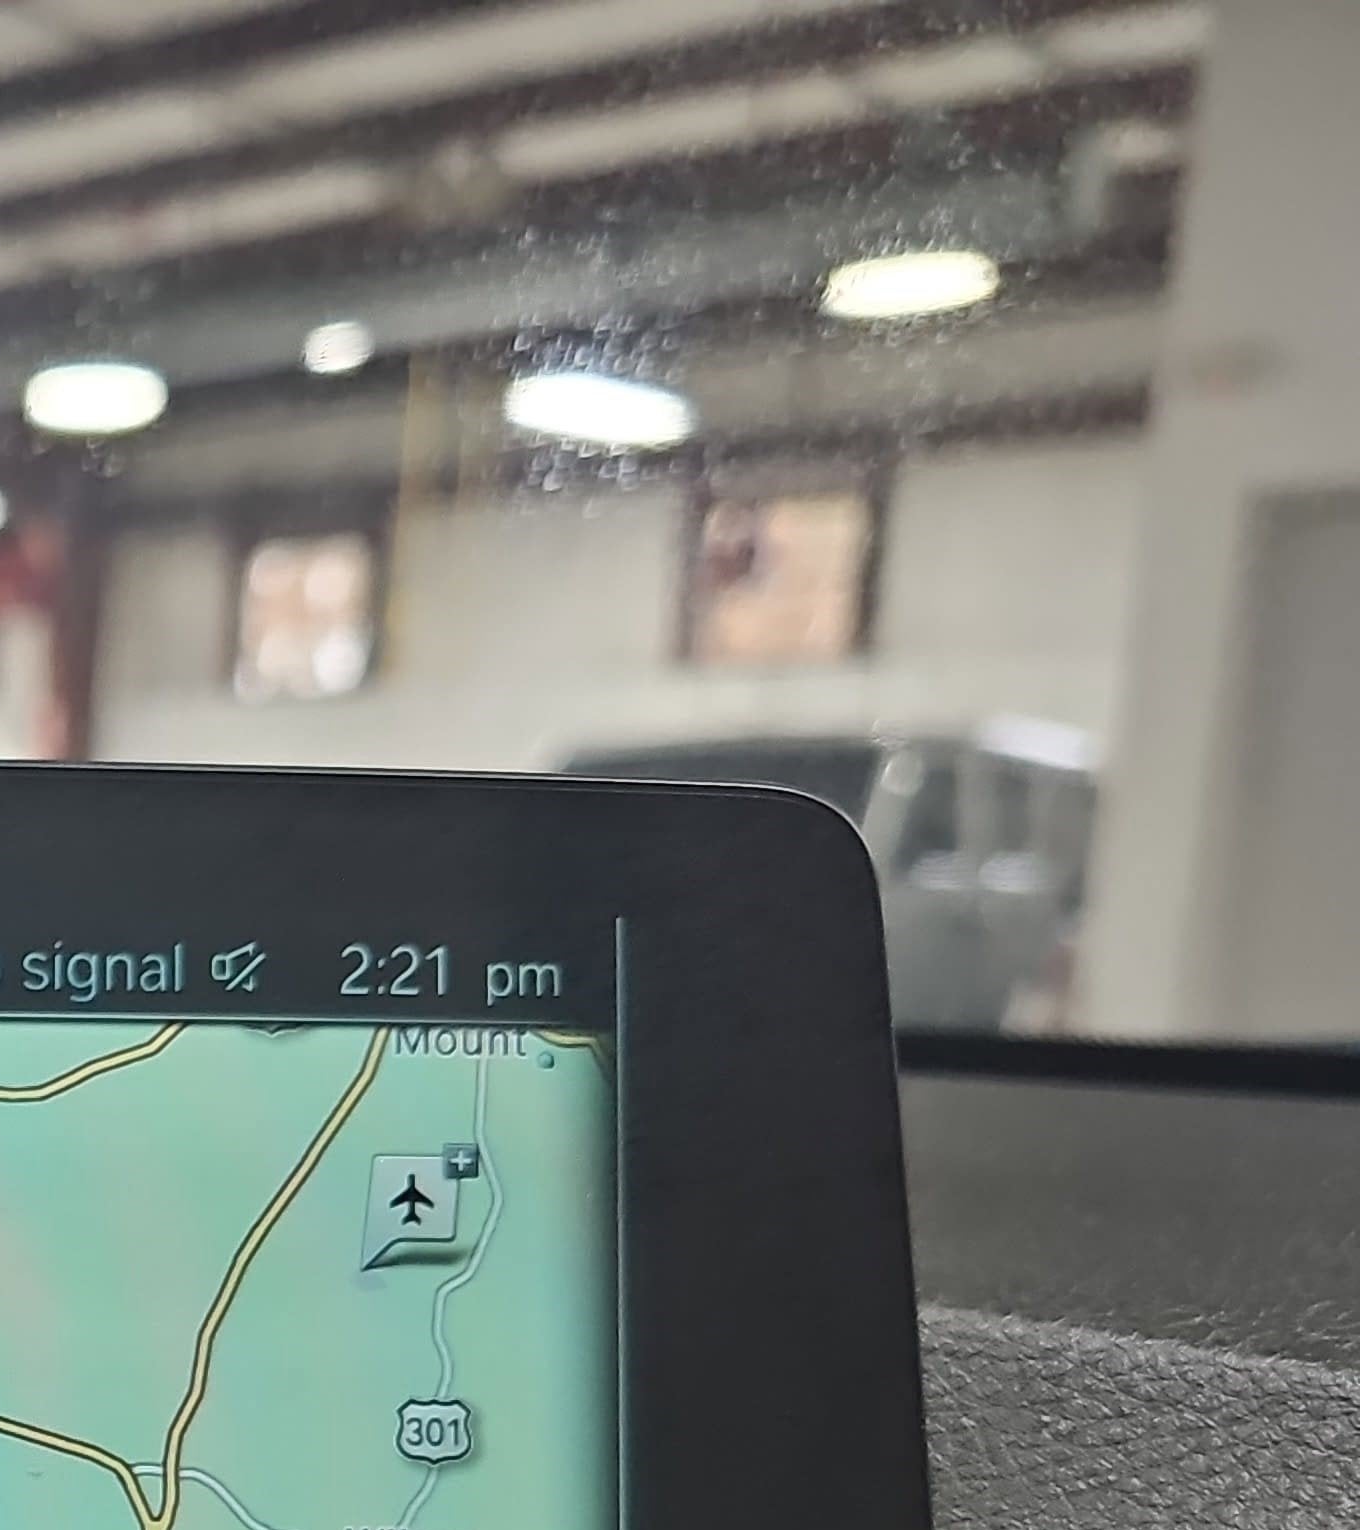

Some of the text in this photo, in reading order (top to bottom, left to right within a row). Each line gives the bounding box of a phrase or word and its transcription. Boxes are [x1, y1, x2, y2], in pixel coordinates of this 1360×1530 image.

[23, 942, 183, 1002] signal
[341, 945, 560, 1005] 2:21 pm
[395, 1027, 526, 1056] Mount
[405, 1418, 460, 1446] 301
